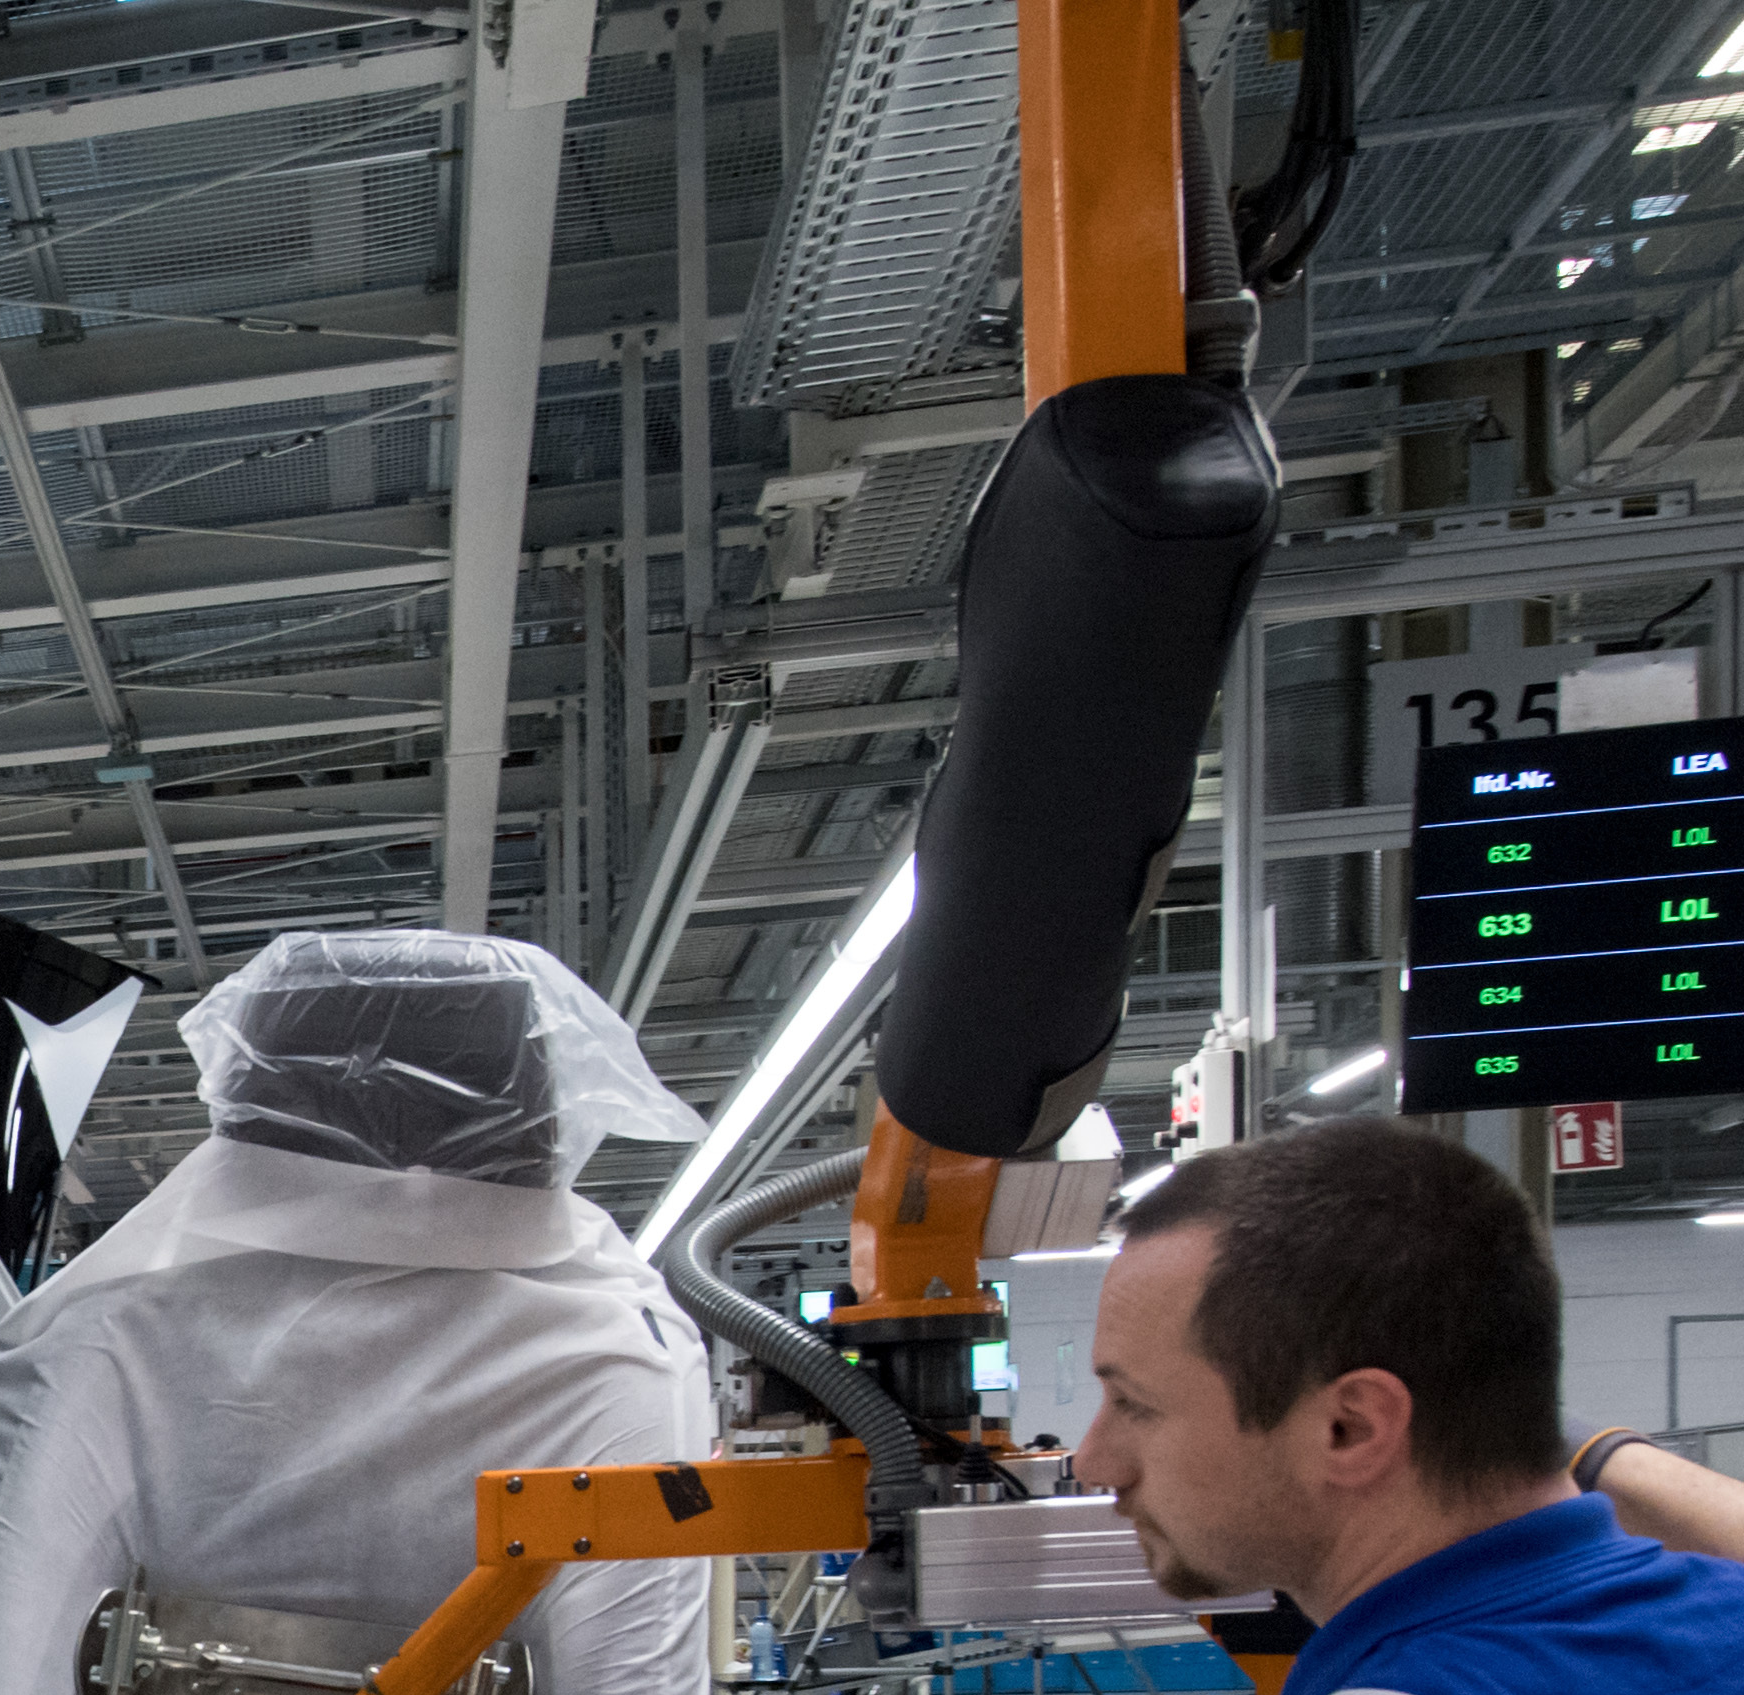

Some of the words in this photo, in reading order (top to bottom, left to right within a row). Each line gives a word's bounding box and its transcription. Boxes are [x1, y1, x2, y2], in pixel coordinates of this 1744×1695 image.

[1405, 680, 1559, 748] 135
[1671, 751, 1730, 776] LEA
[1487, 842, 1533, 865] 632
[1478, 912, 1533, 938] 633
[1479, 985, 1524, 1006] 634
[1475, 1055, 1520, 1076] 635
